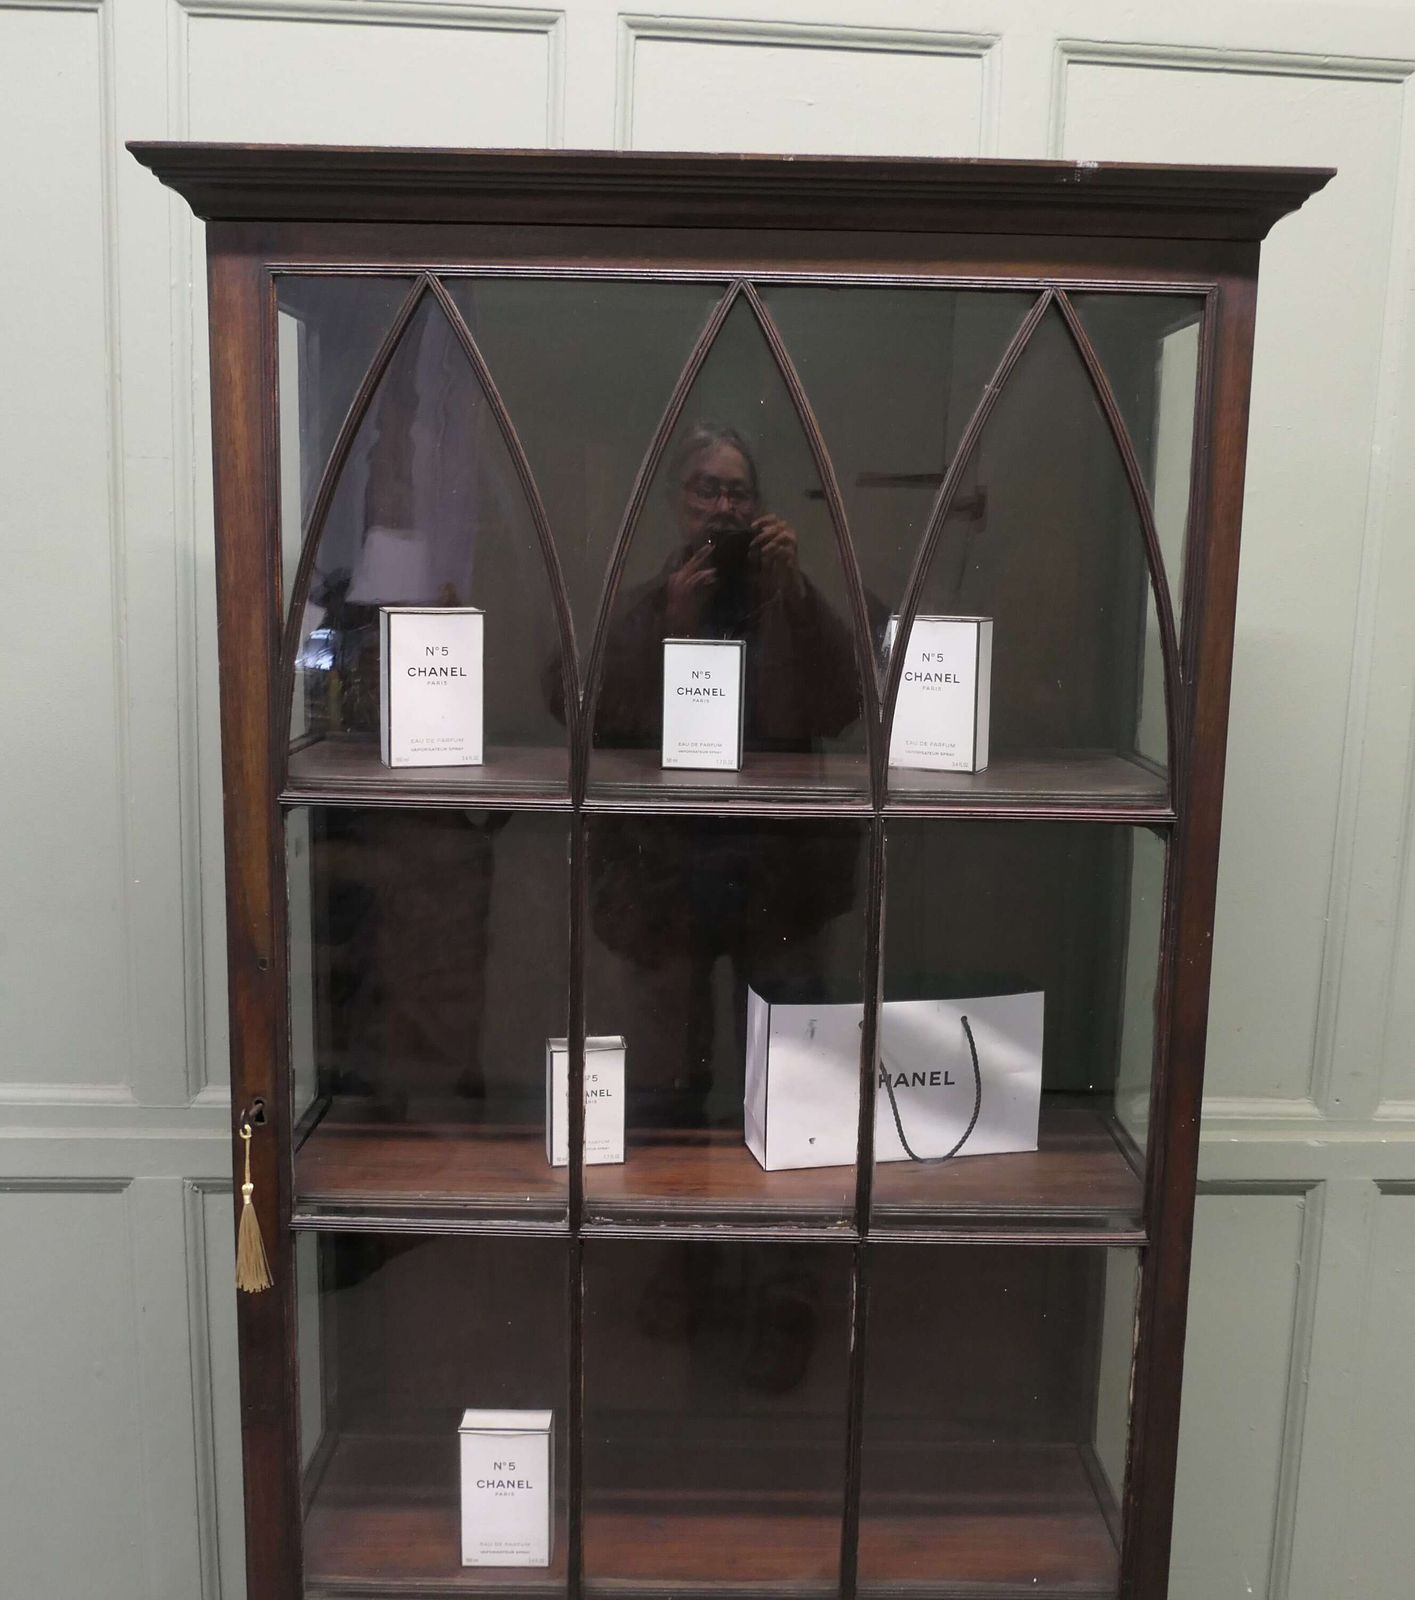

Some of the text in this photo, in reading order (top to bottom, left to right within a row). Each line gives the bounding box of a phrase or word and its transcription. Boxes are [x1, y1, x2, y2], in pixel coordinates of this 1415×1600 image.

[407, 667, 467, 677] CHANEL
[904, 672, 961, 684] CHANEL
[676, 687, 726, 696] CHANEL
[878, 1071, 956, 1088] HANEL
[476, 1480, 533, 1489] CHANEL
